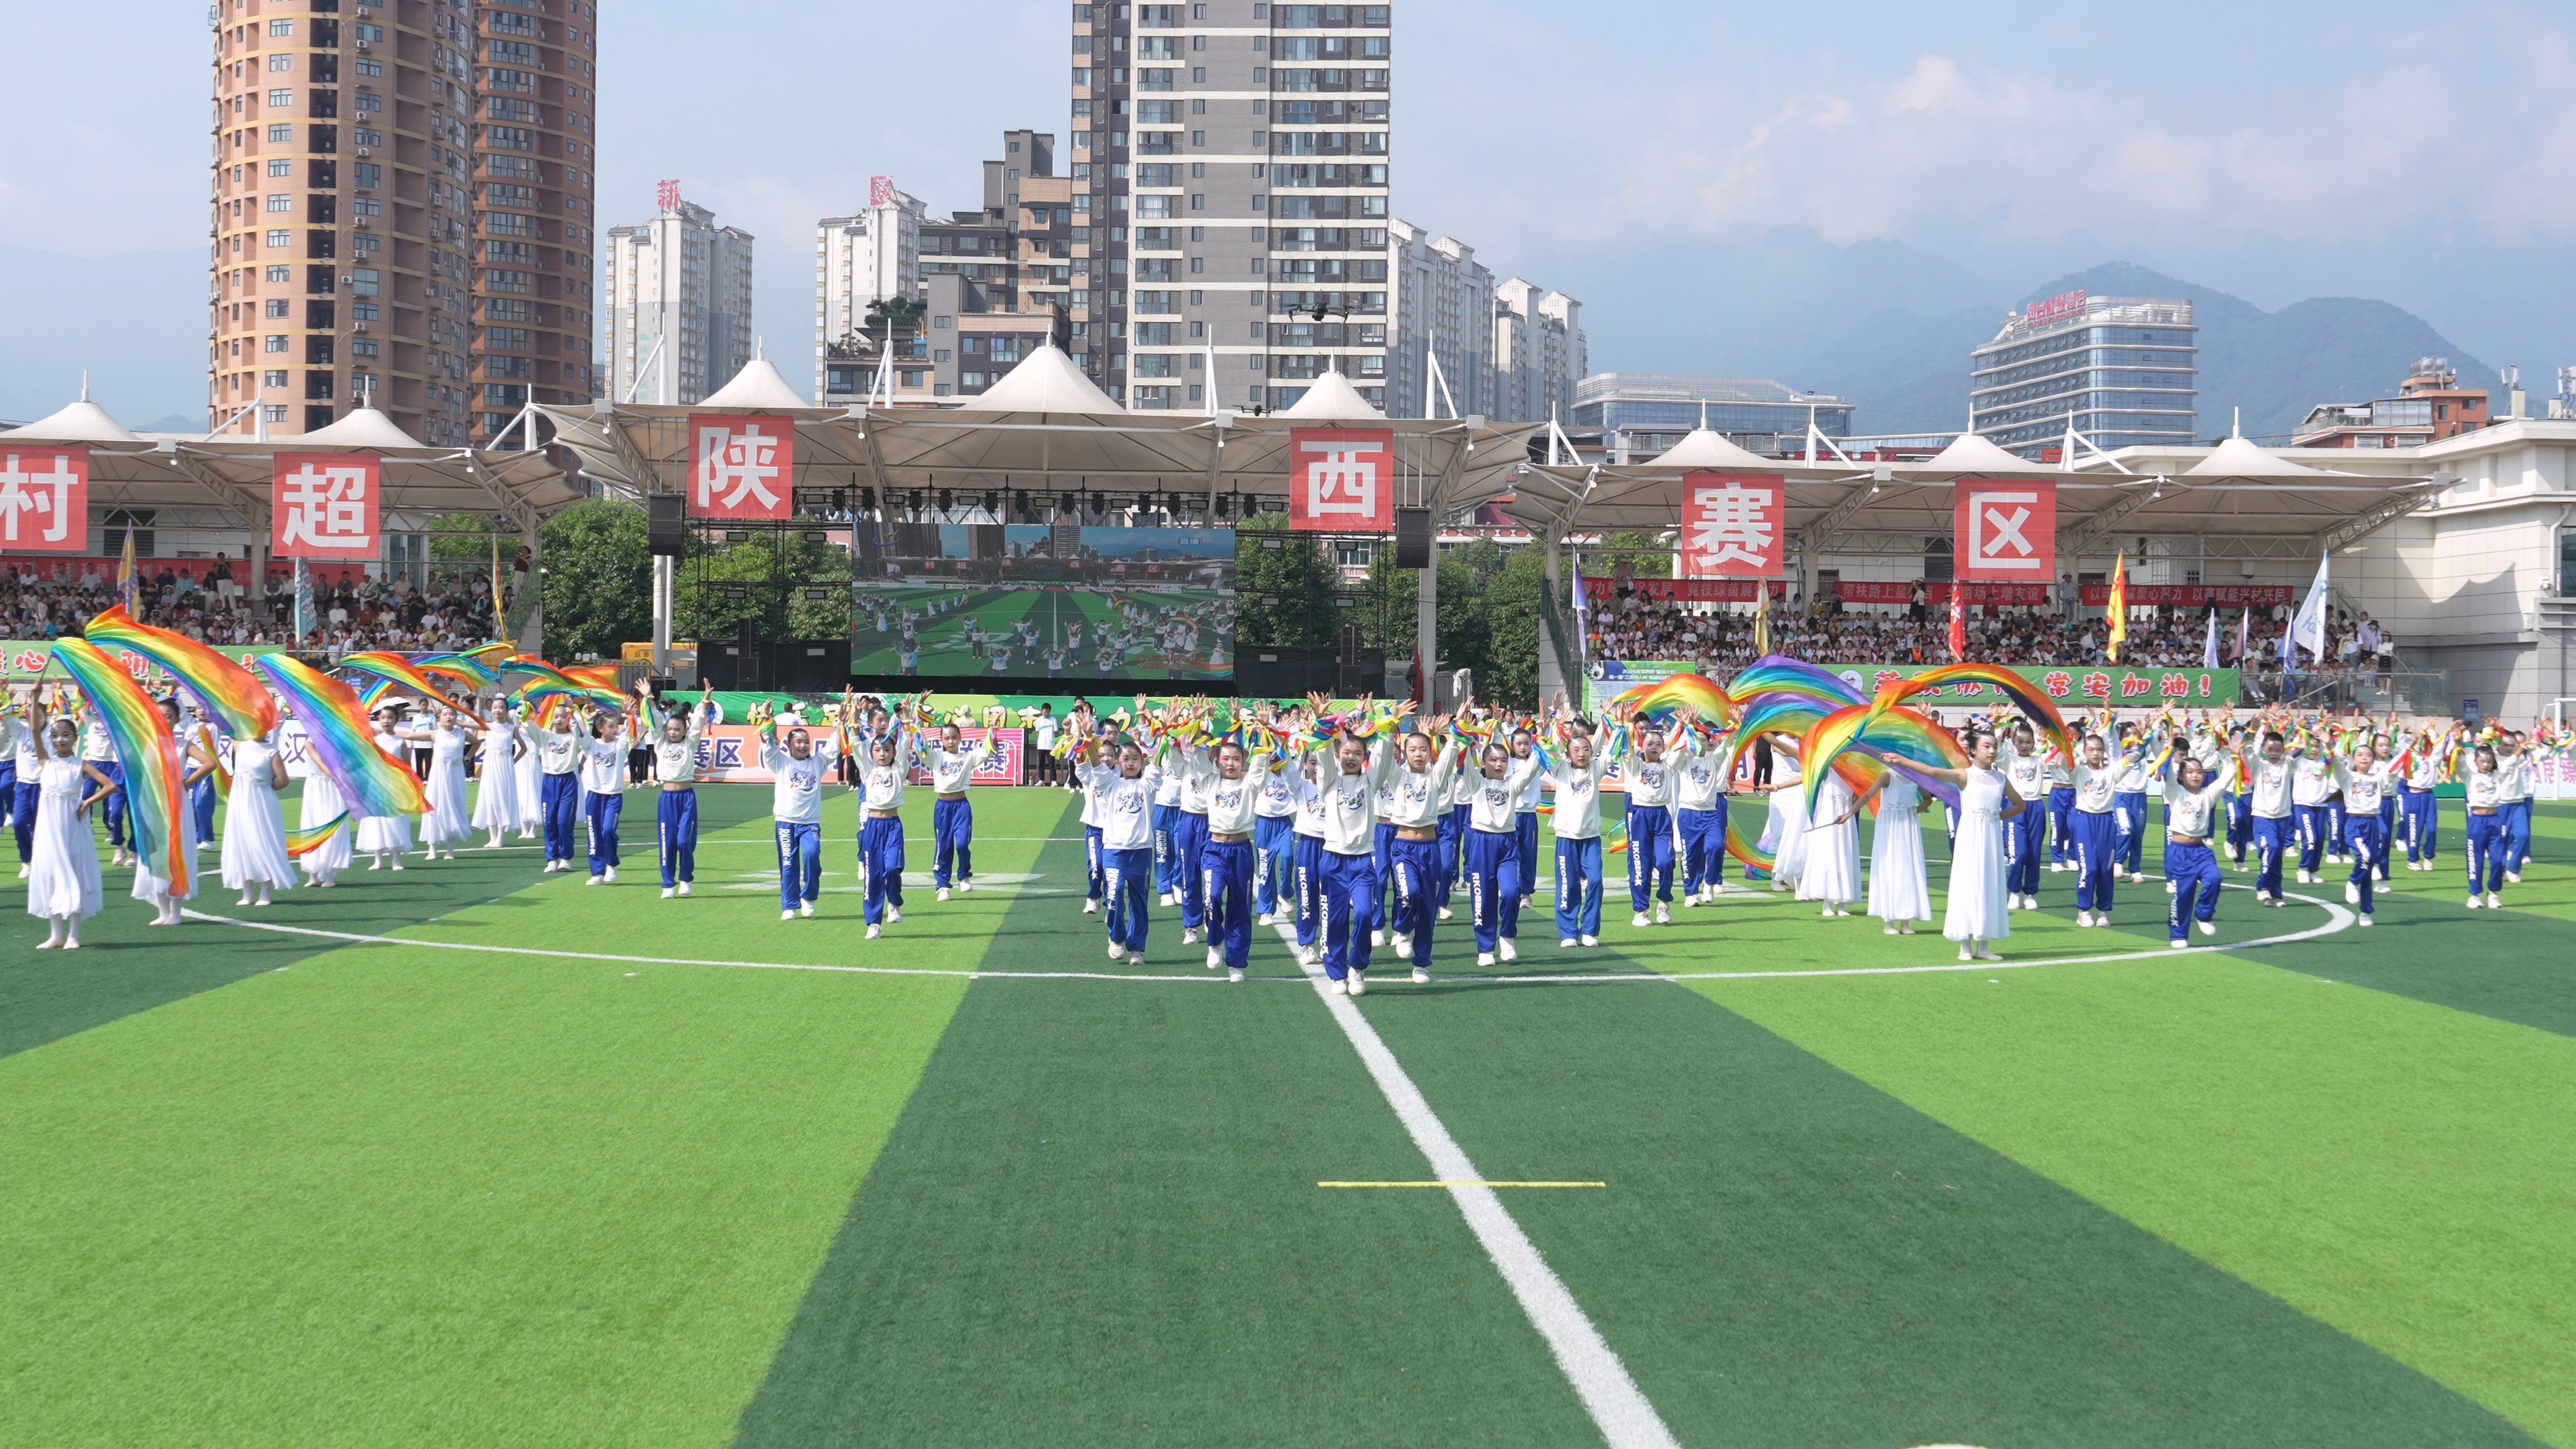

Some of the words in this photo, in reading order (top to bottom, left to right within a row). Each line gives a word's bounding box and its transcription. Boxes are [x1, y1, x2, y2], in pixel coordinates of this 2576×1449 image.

[657, 179, 680, 209] 新
[870, 176, 893, 205] 区
[698, 426, 781, 509] 陕
[1300, 441, 1383, 519] 西
[0, 454, 78, 542] 村
[282, 463, 370, 549] 超
[1691, 482, 1775, 568] 赛
[1968, 492, 2040, 569] 区
[1687, 582, 1779, 597] 竞技绿茵展力
[1843, 583, 1932, 599] 帮扶路上显当
[1949, 585, 2039, 601] 茵场上增友谊
[2091, 586, 2183, 601] 以球媒聚心聚力
[2045, 671, 2211, 699] 常安加油！
[1472, 873, 1482, 926] RKOBBK-K
